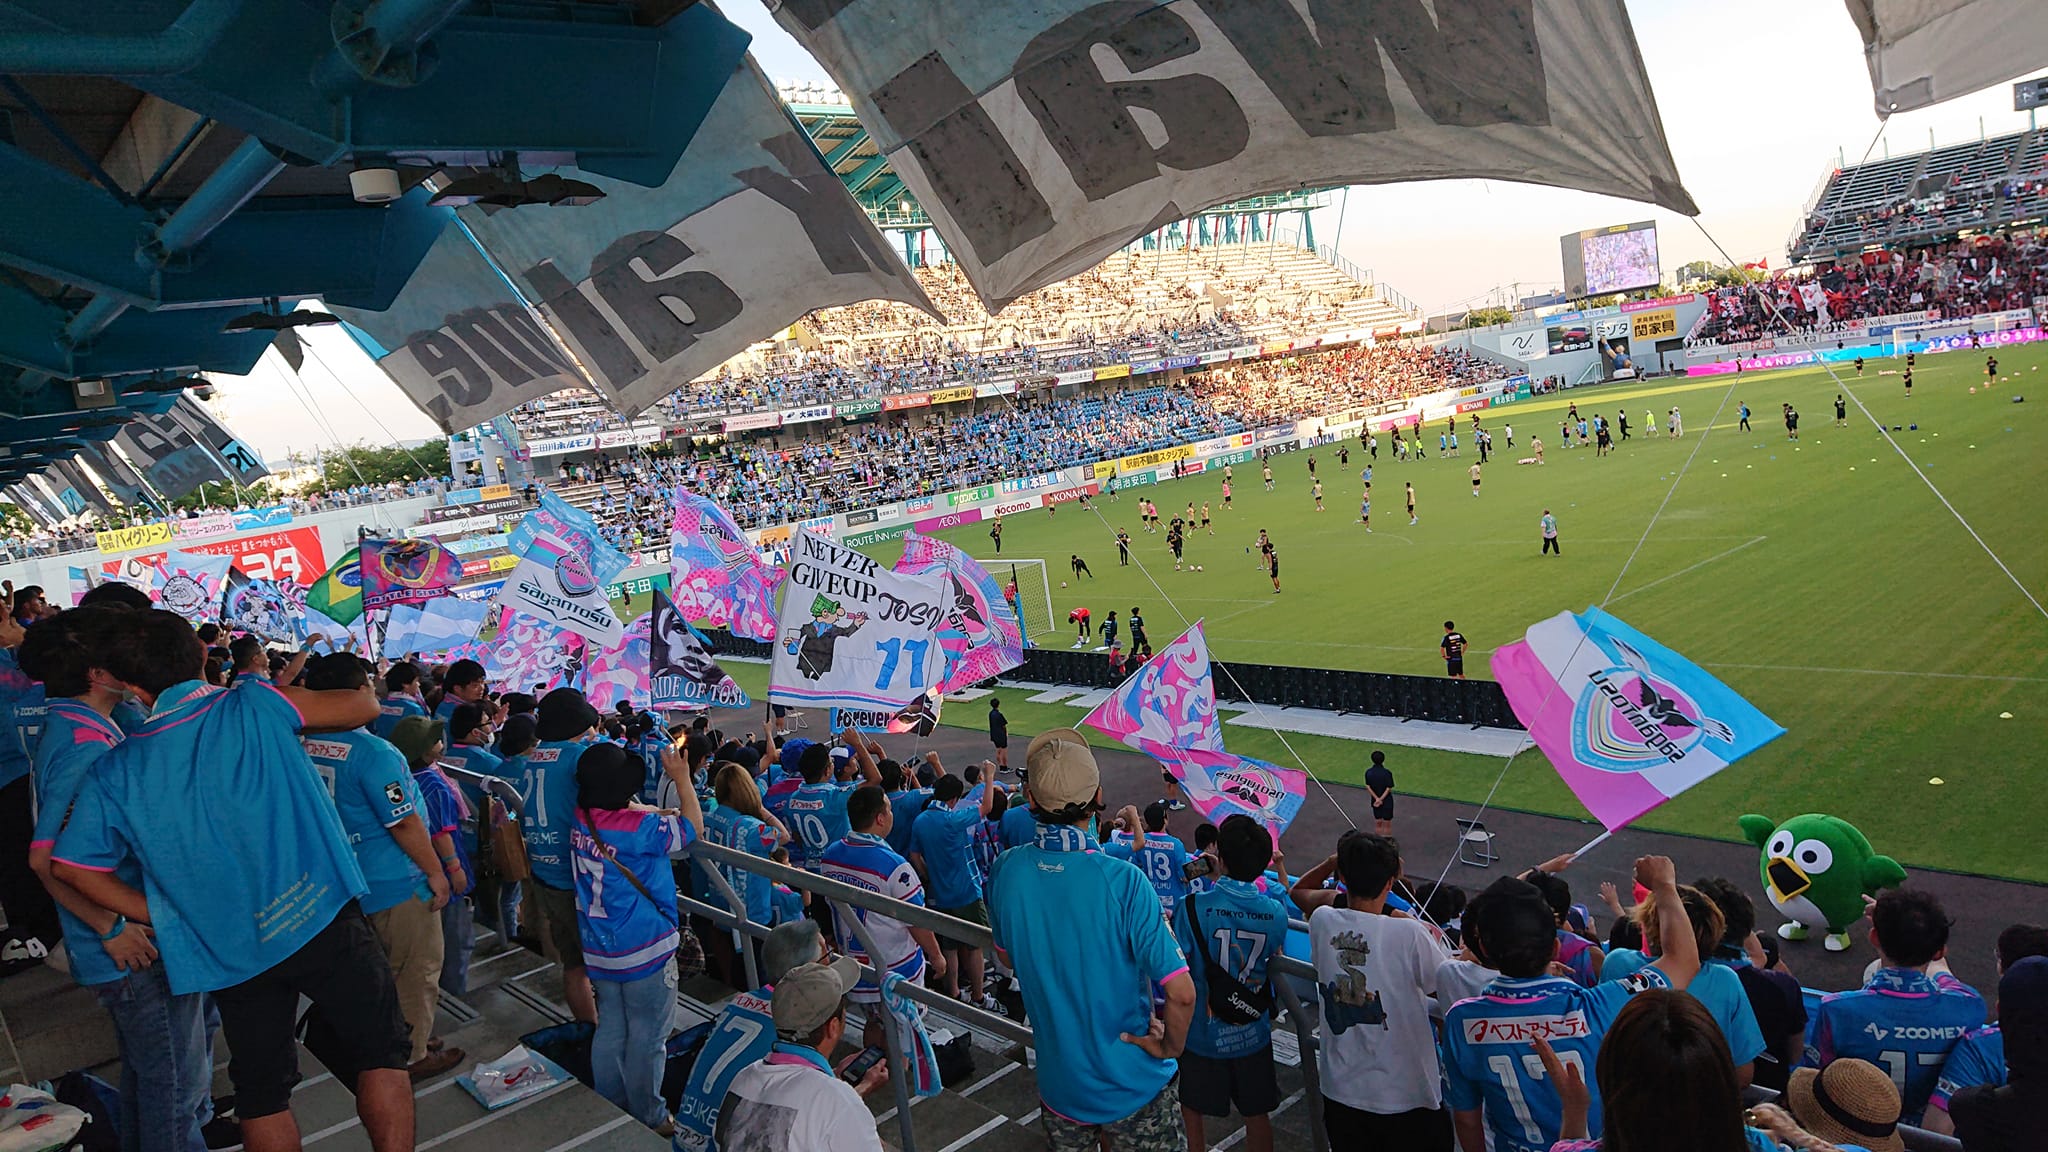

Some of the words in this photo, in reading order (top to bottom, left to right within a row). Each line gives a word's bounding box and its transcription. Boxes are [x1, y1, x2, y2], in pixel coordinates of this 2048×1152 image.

[1634, 322, 1675, 337] 関家具
[1125, 449, 1190, 469] 駅前不動産スタジアム
[1214, 453, 1245, 467] 明治安田
[1114, 475, 1148, 490] 明治安田
[994, 501, 1031, 516] docomo
[115, 525, 170, 547] バイグリーン
[846, 535, 874, 547] ROUTE
[801, 535, 879, 579] NEVER
[607, 578, 652, 598] 治安田
[518, 582, 613, 628] sagantosu
[651, 676, 681, 699] RIDE
[684, 674, 704, 698] OF
[710, 682, 749, 707] TOSU
[836, 710, 890, 729] forever
[792, 812, 829, 849] 10
[1144, 849, 1172, 881] 13
[1215, 908, 1244, 920] TOKYO
[1247, 908, 1274, 920] TOKEN
[1212, 928, 1266, 984] 17
[1227, 991, 1261, 1018] Suprem
[1490, 1018, 1587, 1041] ベストアメニティ
[1894, 1026, 1967, 1040] ZOOMEX
